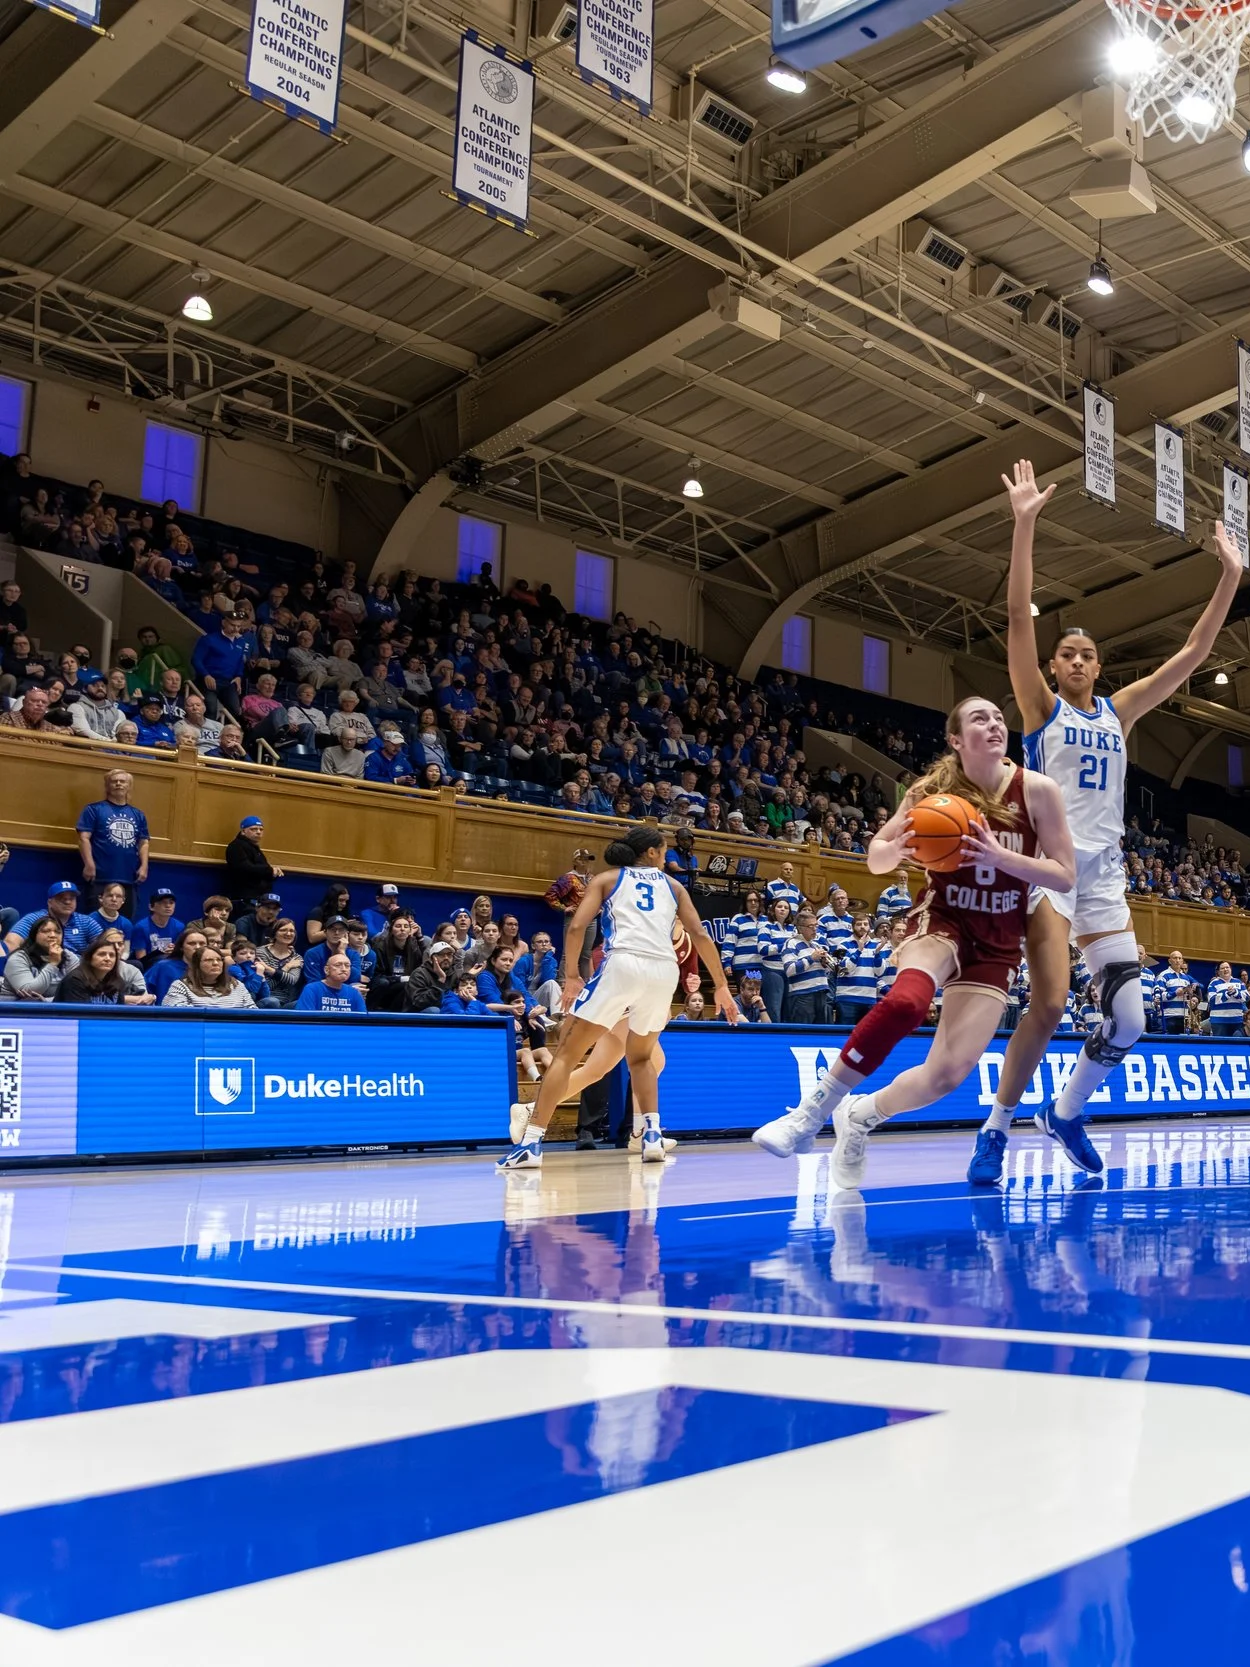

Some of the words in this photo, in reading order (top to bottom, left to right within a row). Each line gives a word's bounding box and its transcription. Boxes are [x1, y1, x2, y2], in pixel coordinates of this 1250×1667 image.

[281, 12, 319, 40] COAST
[584, 0, 650, 48] CONFERENCE
[258, 17, 337, 67] CONFERENCE
[587, 16, 648, 60] CHAMPIONS
[591, 32, 618, 53] REGULAR
[620, 50, 642, 67] SEASON
[260, 34, 332, 80] CHAMPIONS
[596, 44, 637, 72] TOURNAMENT
[264, 54, 296, 76] REGULAR
[299, 72, 326, 91] SEASON
[602, 59, 630, 84] 1963
[277, 76, 310, 102] 2004
[472, 104, 520, 136] ATLANTIC
[479, 121, 512, 146] COAST
[461, 126, 528, 168] CONFERENCE
[464, 141, 525, 180] CHAMPIONS
[474, 163, 513, 188] TOURNAMENT
[478, 180, 506, 203] 2005
[1090, 430, 1110, 447] ATLANTIC
[1093, 441, 1108, 454] COAST
[1086, 447, 1114, 467] CONFERENCE
[1088, 457, 1114, 476] CHAMPIONS
[1161, 464, 1180, 479] ATLANTIC
[1158, 480, 1183, 498] CONFERENCE
[1158, 490, 1182, 507] CHAMPIONS
[1228, 504, 1245, 518] ATLANTIC
[66, 573, 86, 590] 15
[1064, 727, 1122, 753] DUKE
[1079, 754, 1108, 791] 21
[636, 882, 654, 912] 3
[946, 884, 1021, 914] COLLEGE
[264, 1072, 424, 1099] DukeHealth
